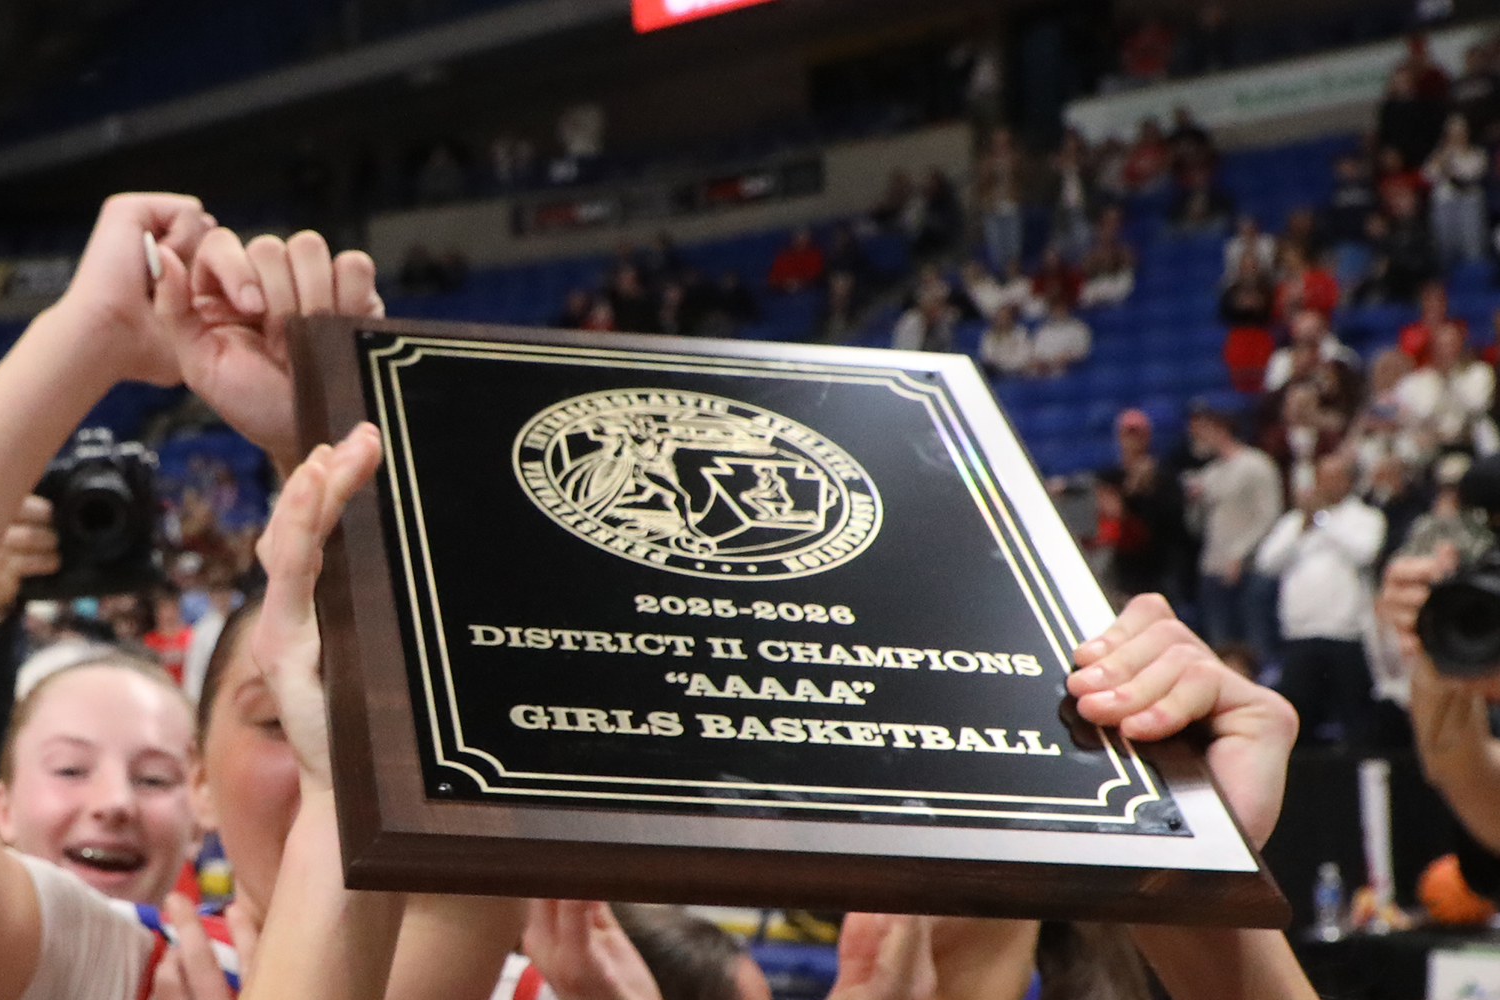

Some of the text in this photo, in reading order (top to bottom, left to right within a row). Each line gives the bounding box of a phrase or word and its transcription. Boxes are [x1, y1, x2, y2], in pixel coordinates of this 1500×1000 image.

[634, 594, 856, 625] 2025-2026
[468, 624, 1043, 676] DISTRICT II CHAMPIONS
[509, 704, 1061, 756] GIRLS BASKETBALL
